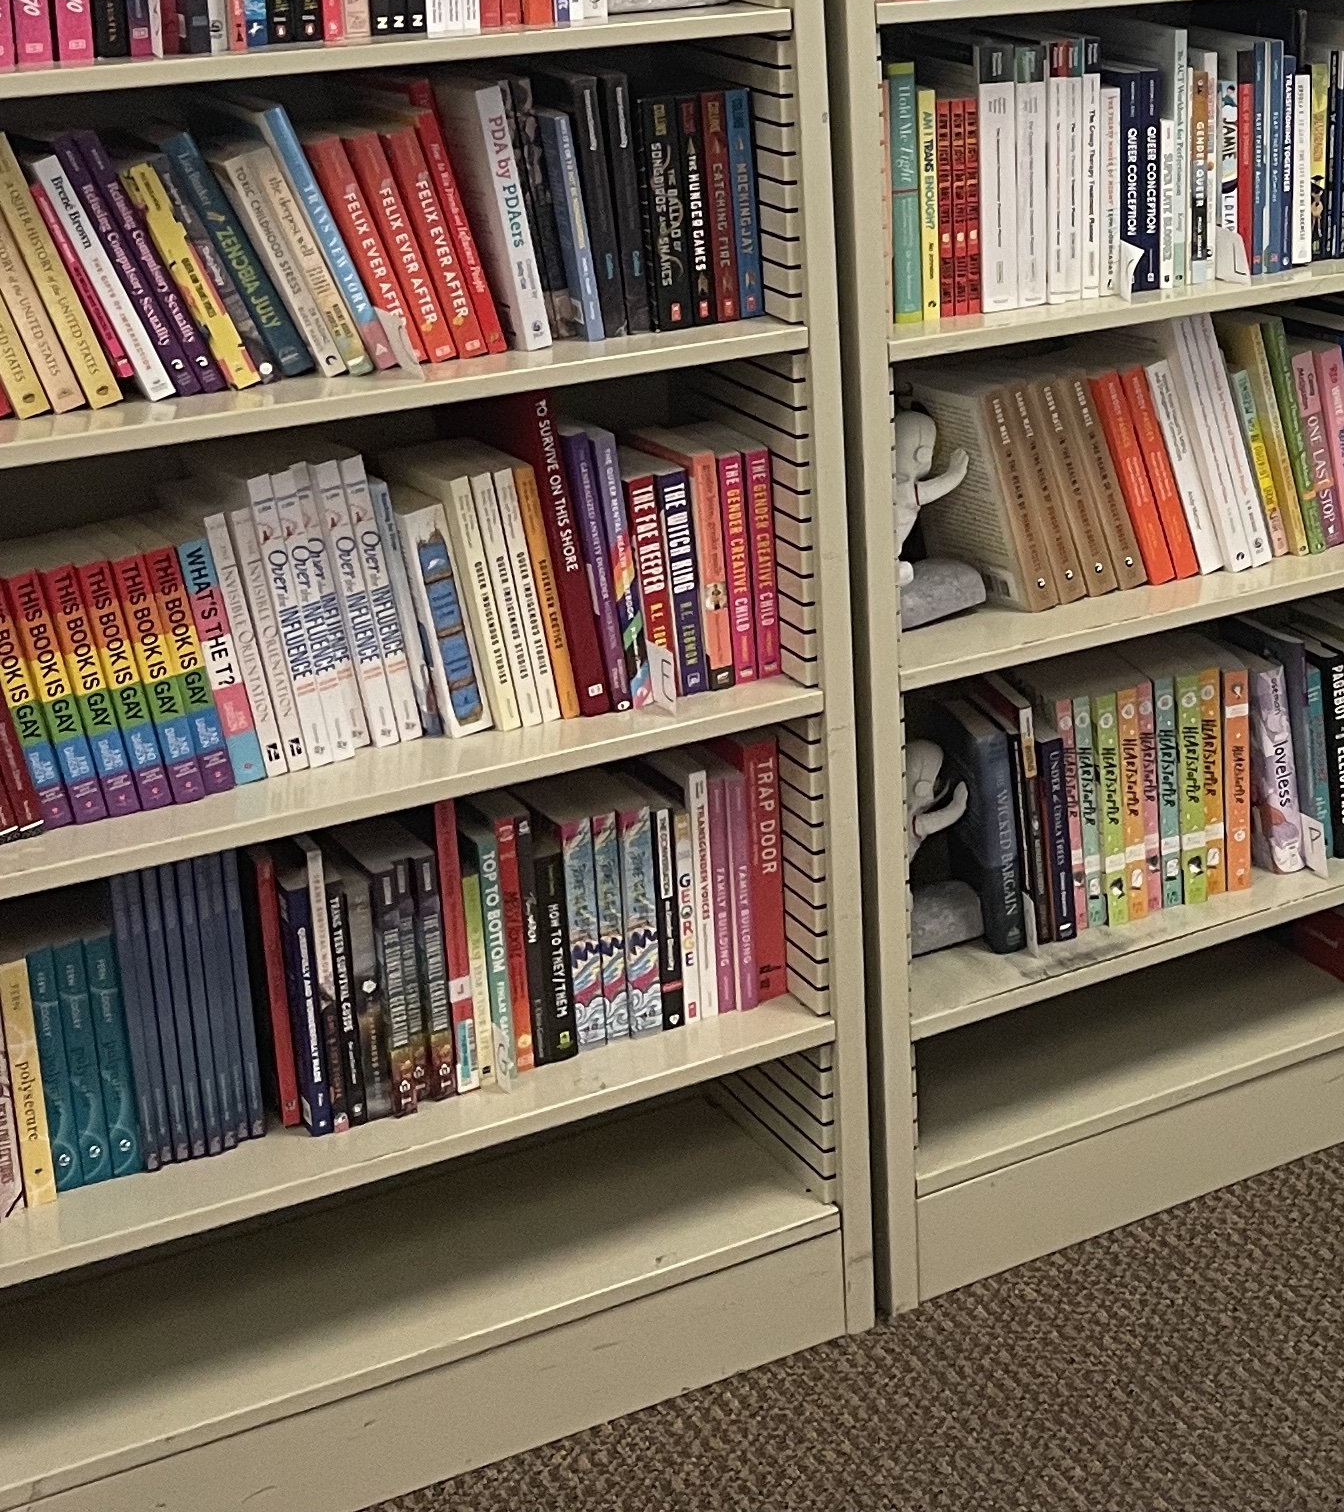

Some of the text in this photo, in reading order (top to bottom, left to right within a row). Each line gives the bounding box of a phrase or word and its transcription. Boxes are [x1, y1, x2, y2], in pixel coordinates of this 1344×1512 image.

[488, 115, 525, 248] PDA by PDAers
[1127, 127, 1138, 236] QUEER CONCEPTION
[1222, 118, 1237, 160] JAMIE
[51, 176, 92, 250] Brené Brown
[712, 163, 731, 268] CATCHING FIRE
[736, 163, 754, 255] MOCKINGJAY
[1195, 169, 1204, 207] QUEER
[381, 187, 438, 324] FELIX EVER AFTER
[535, 399, 579, 573] TO SURVIVE ON THIS SHORE
[663, 483, 695, 595] THE WITCH KING
[0, 627, 23, 684] BOOK
[18, 580, 77, 734] THIS BOOK IS GAY
[186, 547, 235, 687] WHAT'S THE T?
[11, 684, 29, 704] IS
[16, 705, 42, 740] GAY
[757, 757, 777, 874] TRAP DOOR
[1064, 747, 1077, 818] HEARTSTOPPER
[1272, 740, 1293, 807] loveless
[483, 851, 505, 973] TOP TO BOTTOM
[680, 873, 694, 966] GEORGE
[14, 1060, 40, 1141] polysecure
